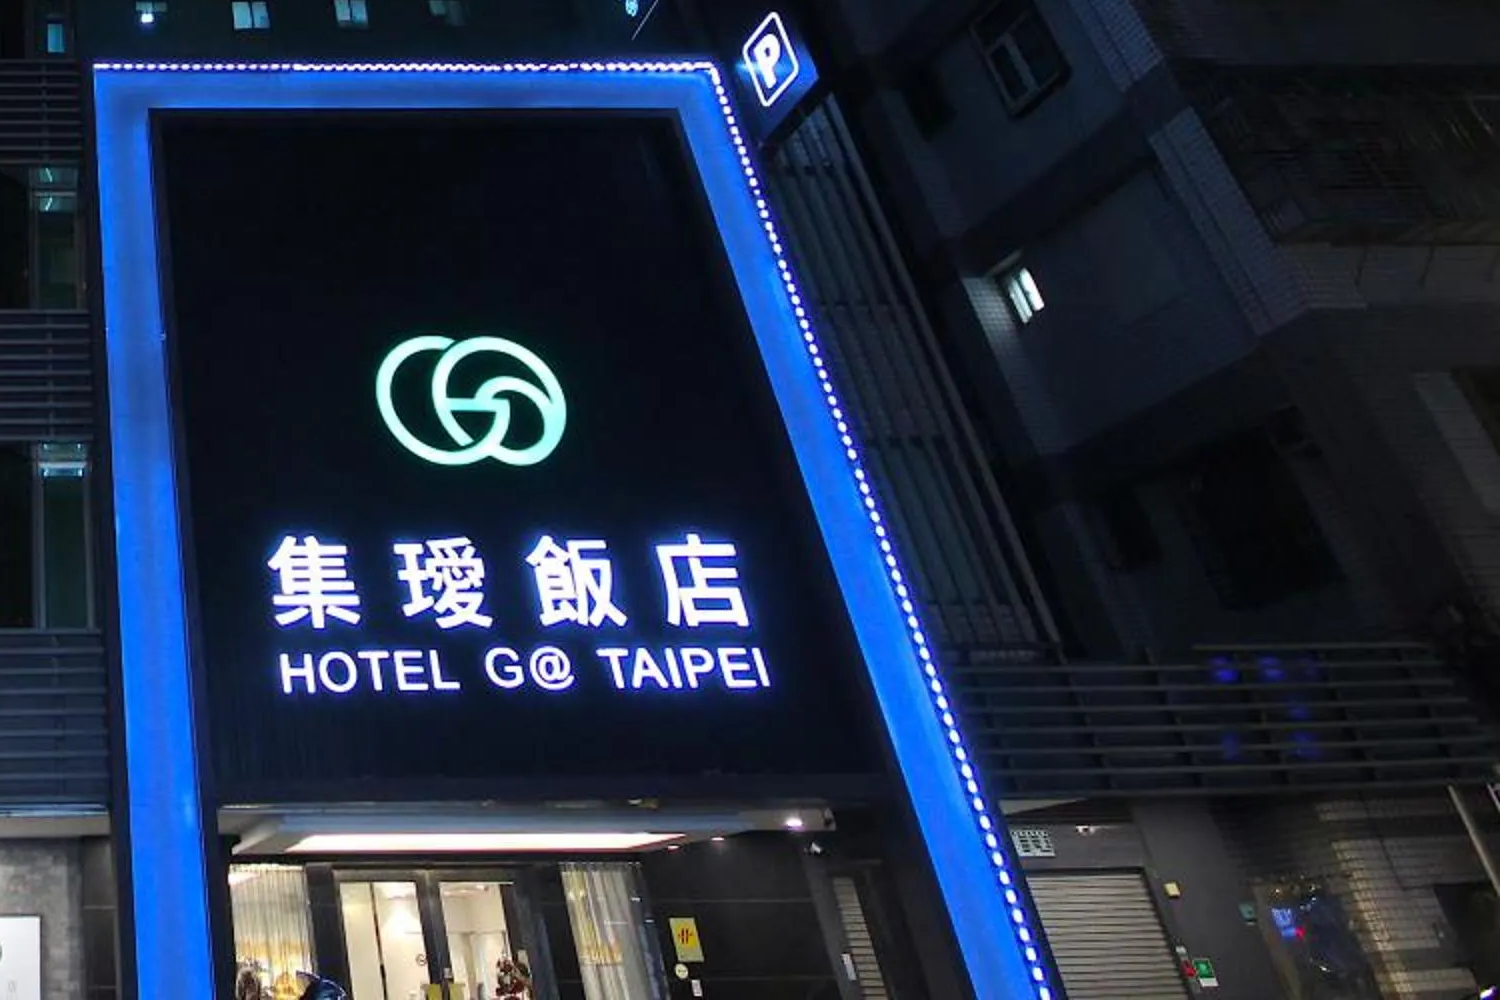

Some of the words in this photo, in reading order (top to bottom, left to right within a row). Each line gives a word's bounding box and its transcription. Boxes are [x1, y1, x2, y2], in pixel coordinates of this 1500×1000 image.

[754, 33, 781, 89] P
[267, 533, 751, 630] 集璦飯店
[279, 649, 461, 694] HOTEL
[484, 645, 576, 692] G@
[595, 647, 772, 690] TAIPEI
